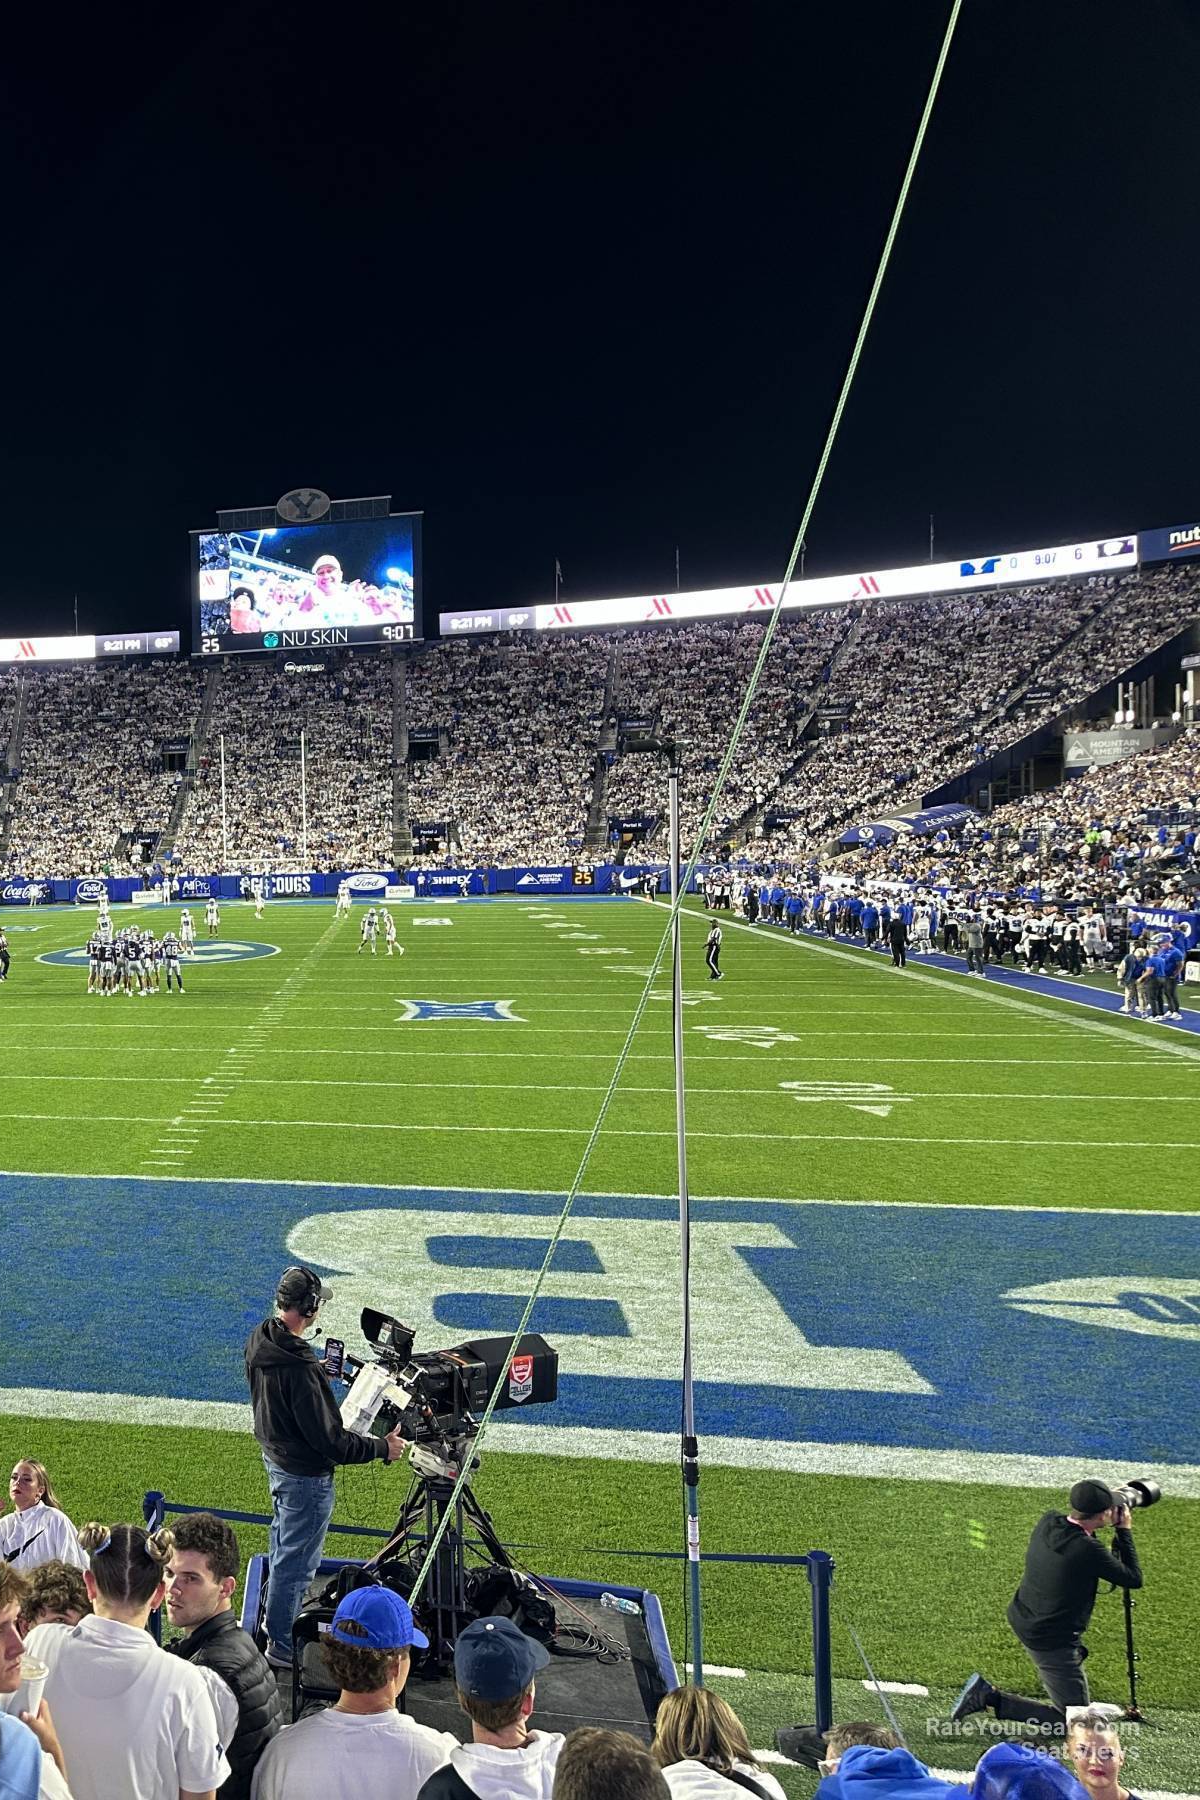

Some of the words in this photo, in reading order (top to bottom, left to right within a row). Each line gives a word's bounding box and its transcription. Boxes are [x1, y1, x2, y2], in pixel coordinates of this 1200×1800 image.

[287, 492, 321, 518] Y
[1035, 552, 1057, 565] 9:07
[282, 631, 307, 646] NU
[311, 629, 349, 645] SKIN
[382, 625, 413, 639] 9:07
[202, 639, 219, 652] 25
[1090, 740, 1140, 749] MOUNTAIN
[1093, 747, 1136, 756] AMERICA
[921, 814, 952, 828] ZIONS
[575, 872, 592, 885] 25
[128, 947, 136, 958] 5
